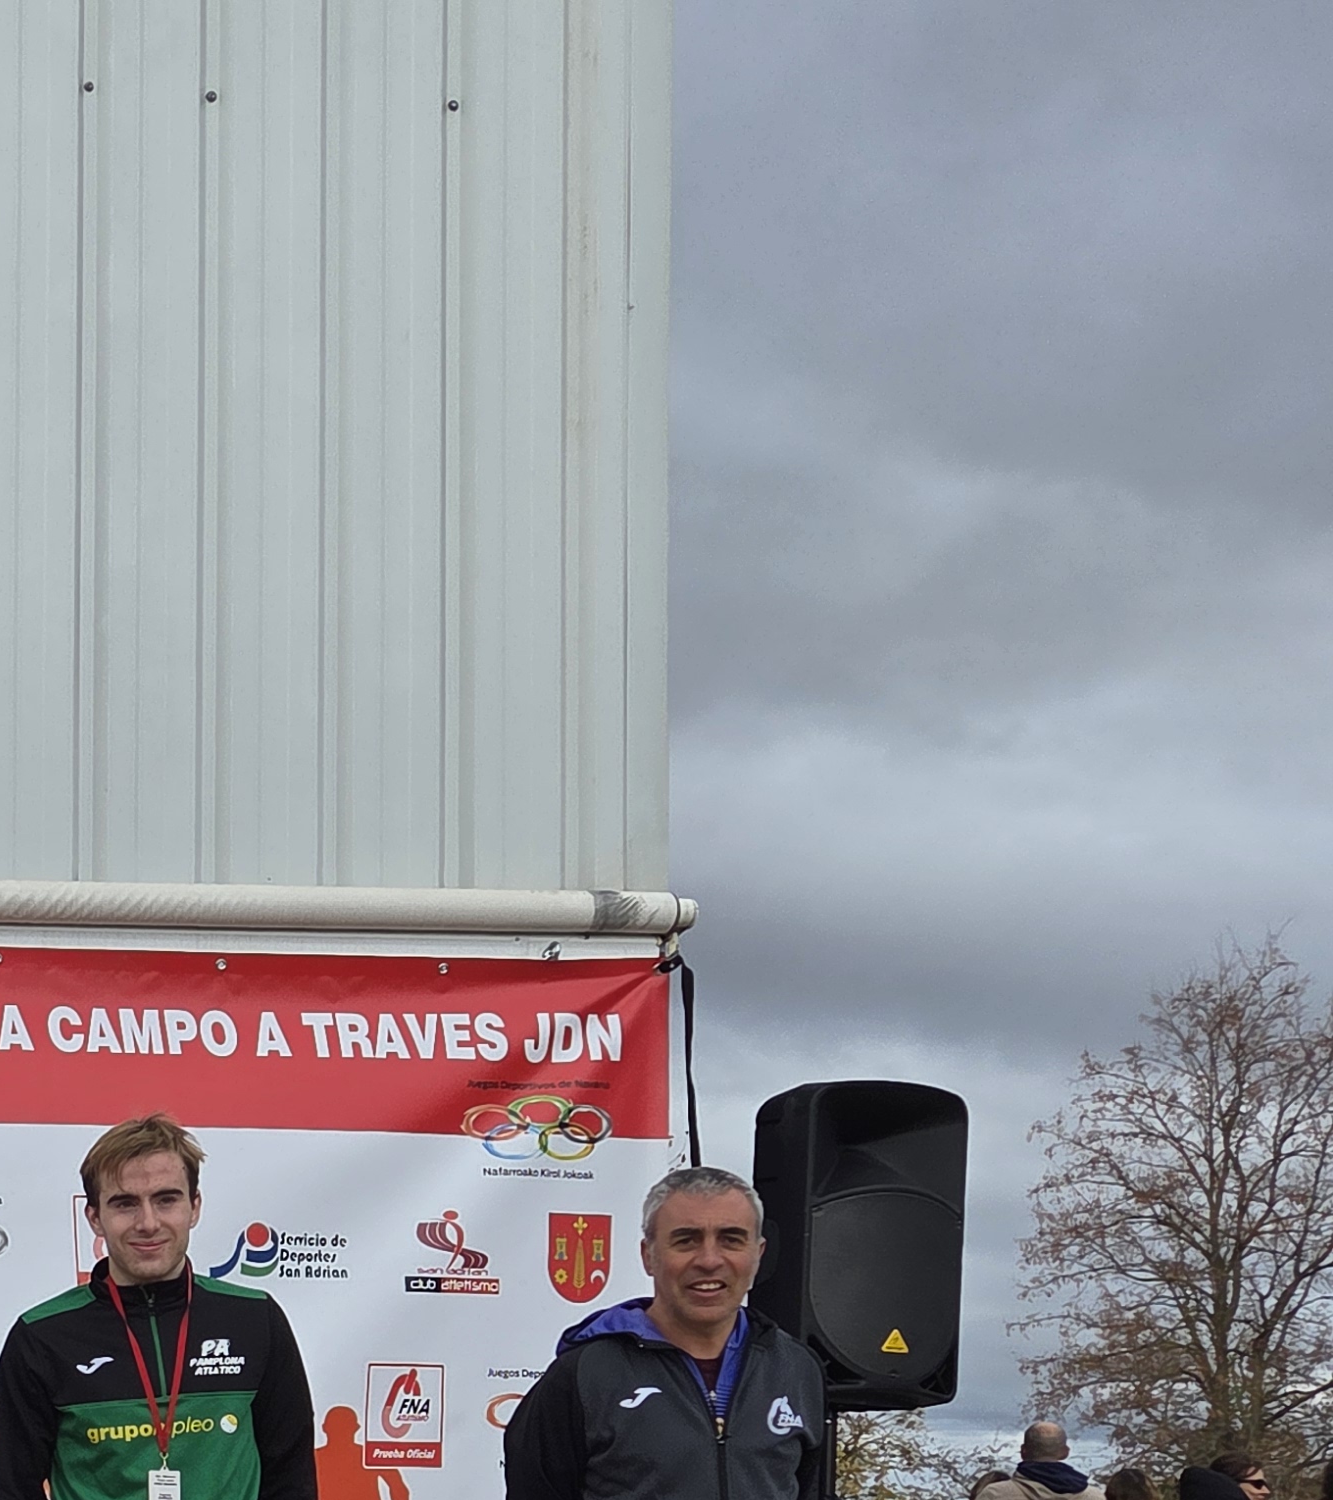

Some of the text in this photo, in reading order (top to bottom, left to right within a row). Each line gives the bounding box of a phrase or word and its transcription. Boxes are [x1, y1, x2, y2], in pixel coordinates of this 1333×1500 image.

[47, 1005, 238, 1057] CAMPO
[256, 1011, 293, 1057] A
[300, 1013, 509, 1062] TRAVES
[524, 1012, 623, 1063] JDN
[331, 1233, 347, 1247] de
[280, 1248, 337, 1264] Deportes
[278, 1264, 349, 1279] San Adrian
[410, 1278, 437, 1291] club
[189, 1356, 245, 1368] PAMPLONA
[487, 1368, 520, 1379] Juegos
[398, 1398, 431, 1415] FNA
